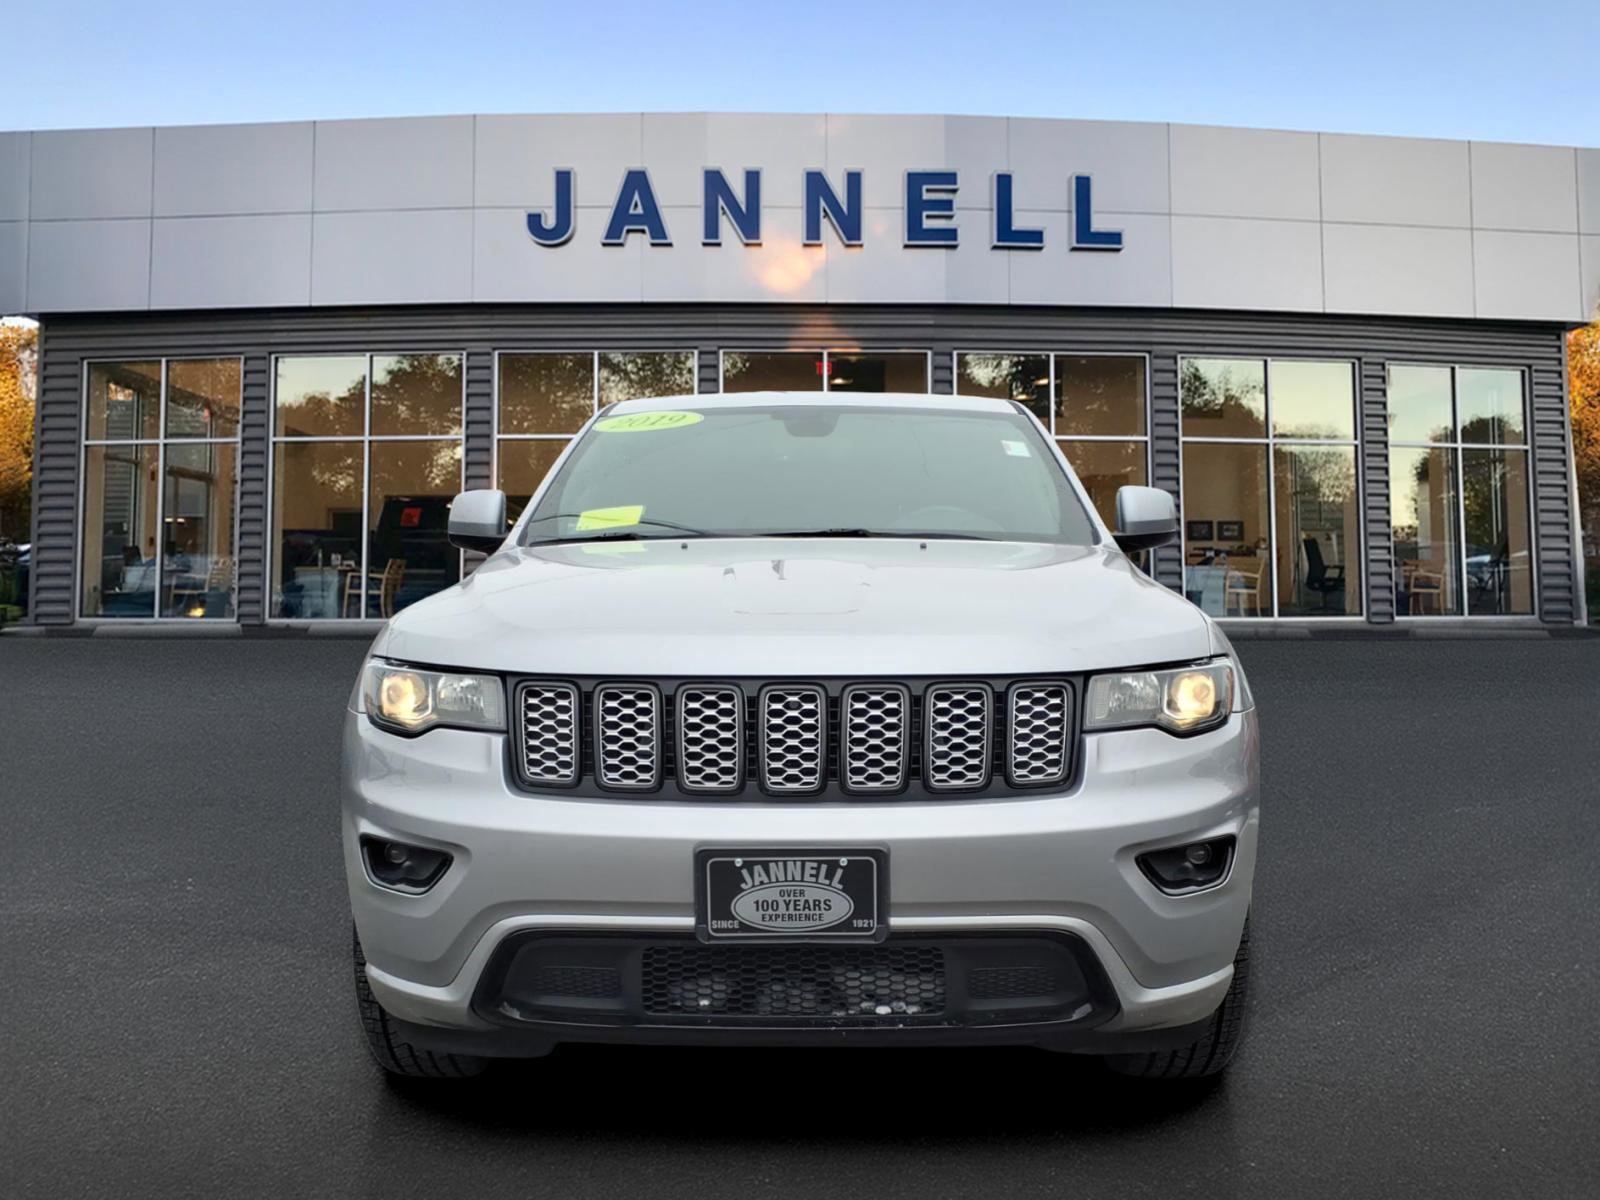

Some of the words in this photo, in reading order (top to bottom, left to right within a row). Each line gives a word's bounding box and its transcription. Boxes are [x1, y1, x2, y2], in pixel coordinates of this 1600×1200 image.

[525, 166, 1124, 249] JANNELL
[609, 413, 687, 430] 2019
[740, 860, 844, 890] JANNELL
[779, 888, 806, 898] OVER
[753, 899, 780, 912] 100
[783, 898, 833, 912] YEARS
[761, 912, 825, 922] EXPERIENCE
[852, 918, 874, 928] 1921
[711, 919, 740, 929] SINCE
